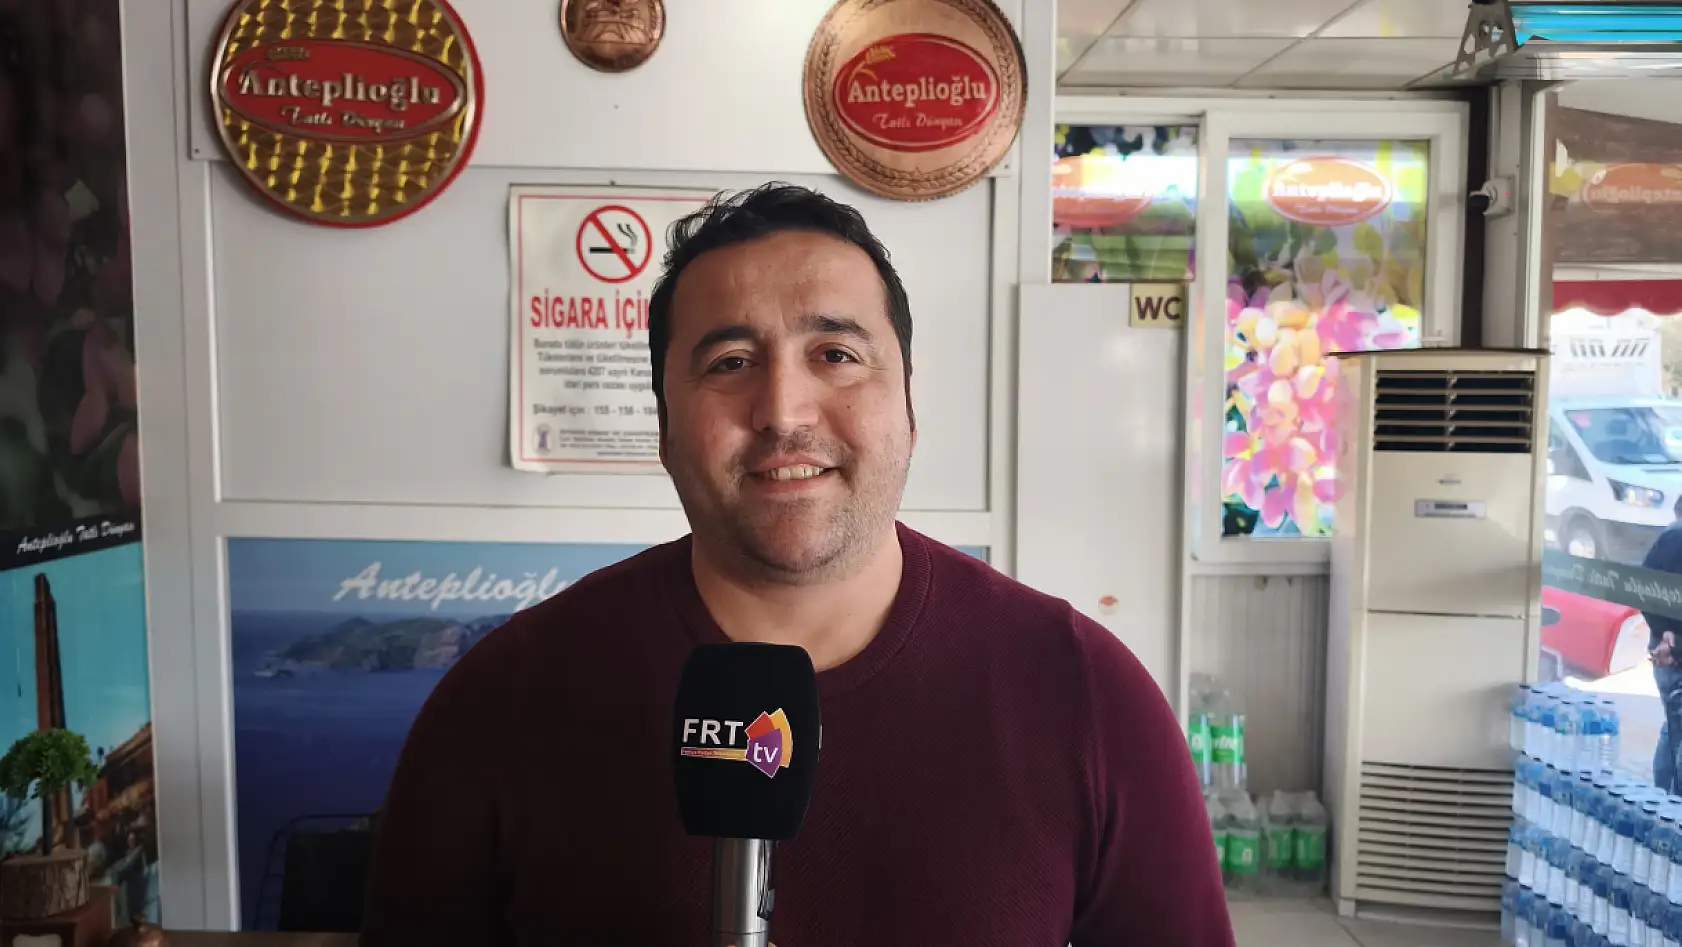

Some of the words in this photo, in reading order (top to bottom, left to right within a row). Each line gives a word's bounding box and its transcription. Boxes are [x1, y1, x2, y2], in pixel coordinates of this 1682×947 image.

[240, 68, 440, 110] Anteplioğlu
[848, 75, 989, 108] Anteplioğlu
[530, 288, 608, 329] SİGARA
[1134, 296, 1181, 320] WC
[682, 718, 744, 746] FRT
[753, 742, 779, 763] tv
